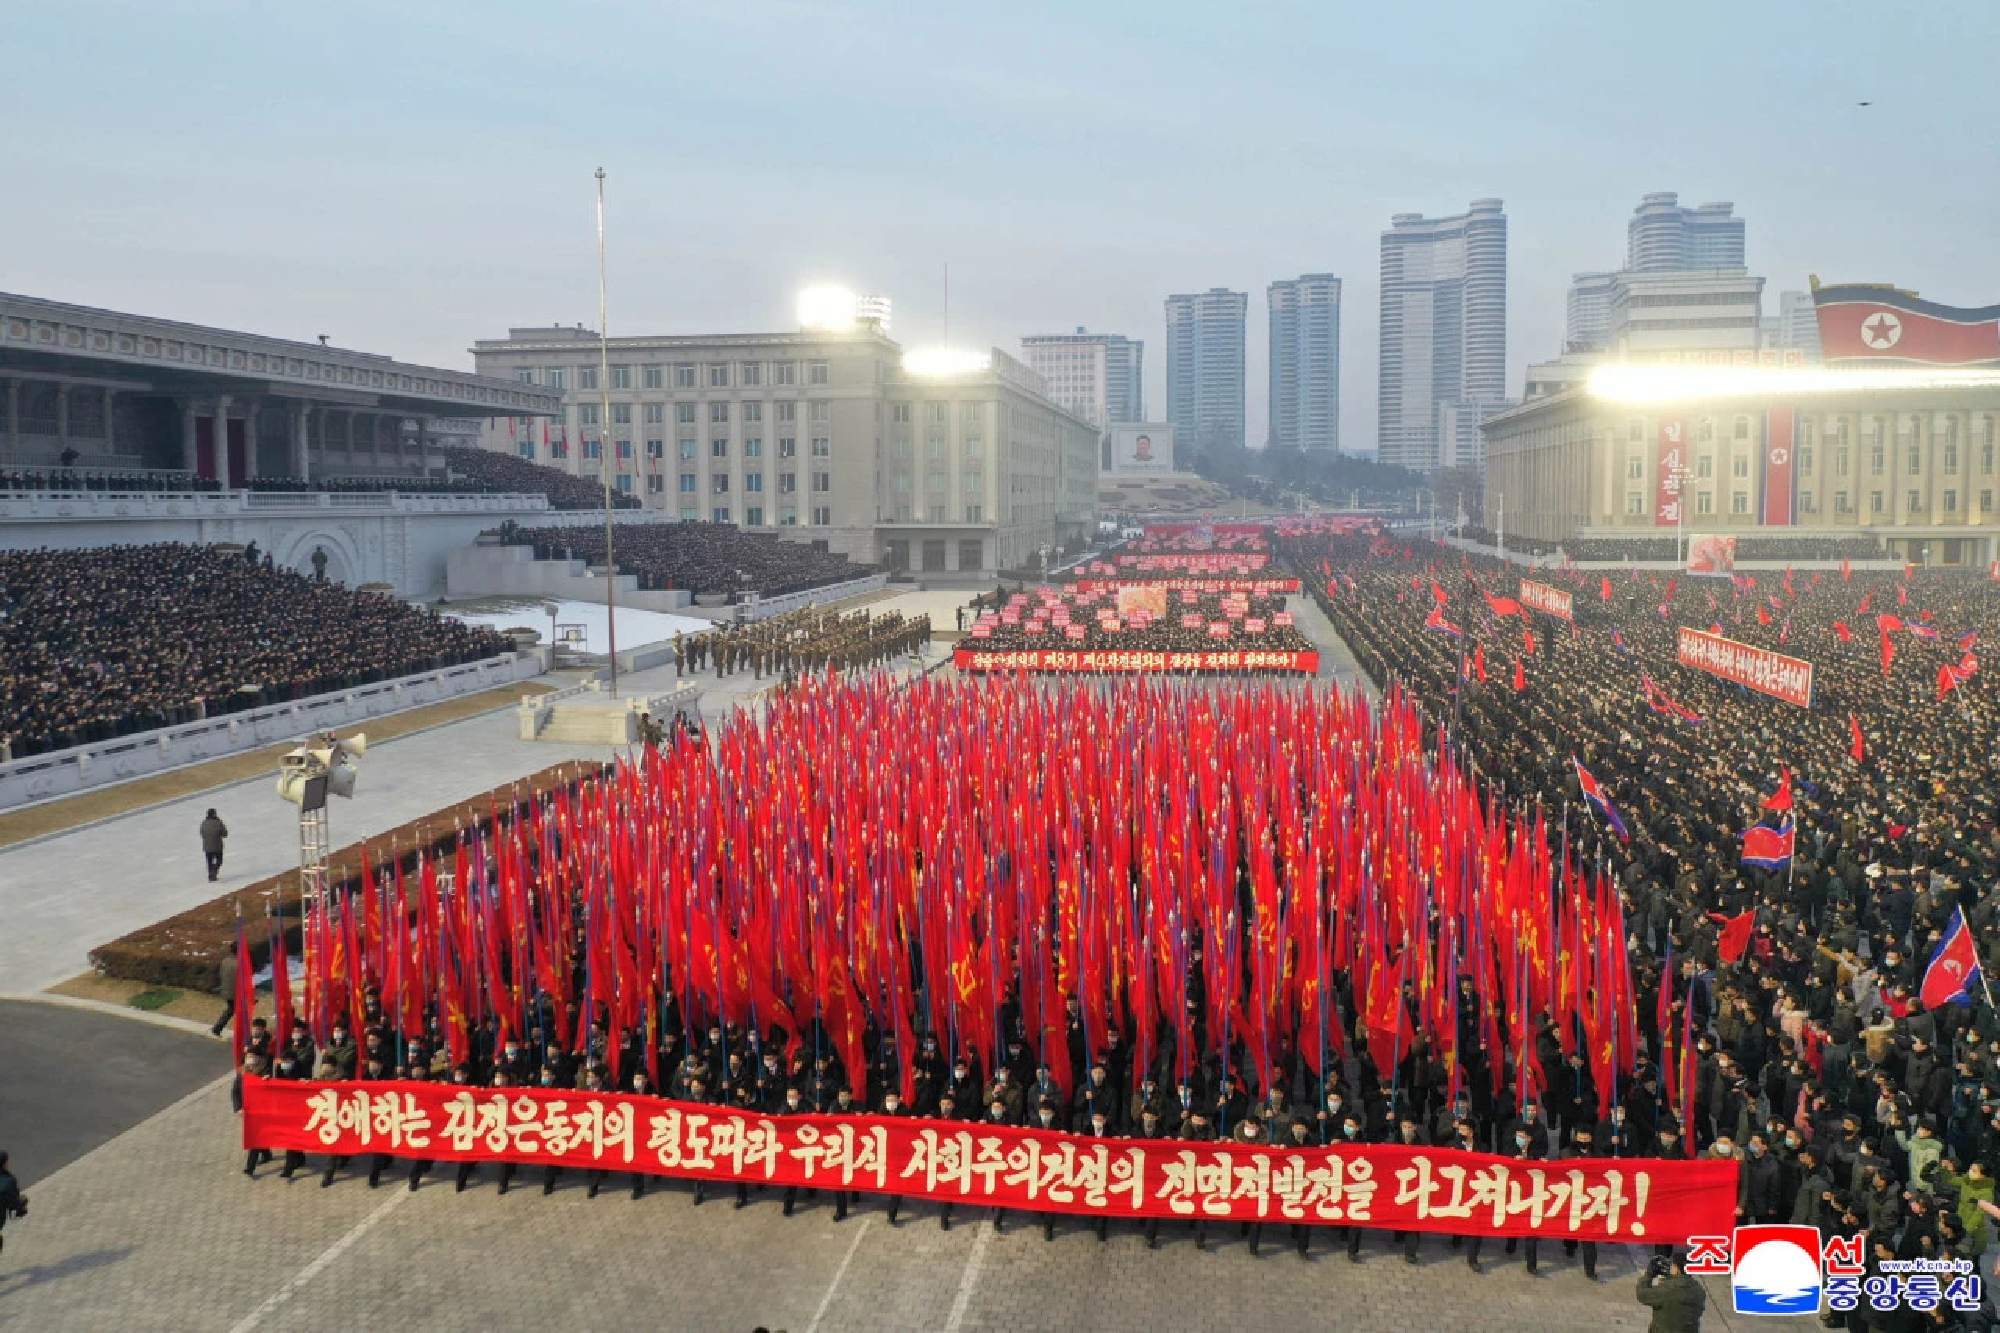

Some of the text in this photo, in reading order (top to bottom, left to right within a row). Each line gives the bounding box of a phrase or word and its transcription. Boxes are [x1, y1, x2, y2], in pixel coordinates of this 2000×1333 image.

[1044, 652, 1078, 668] 제8기
[303, 1088, 1651, 1236] 경애하는 김정은동지의 령도따라 우리식 사회주의건설의 전면적발전을 다그쳐나가자!
